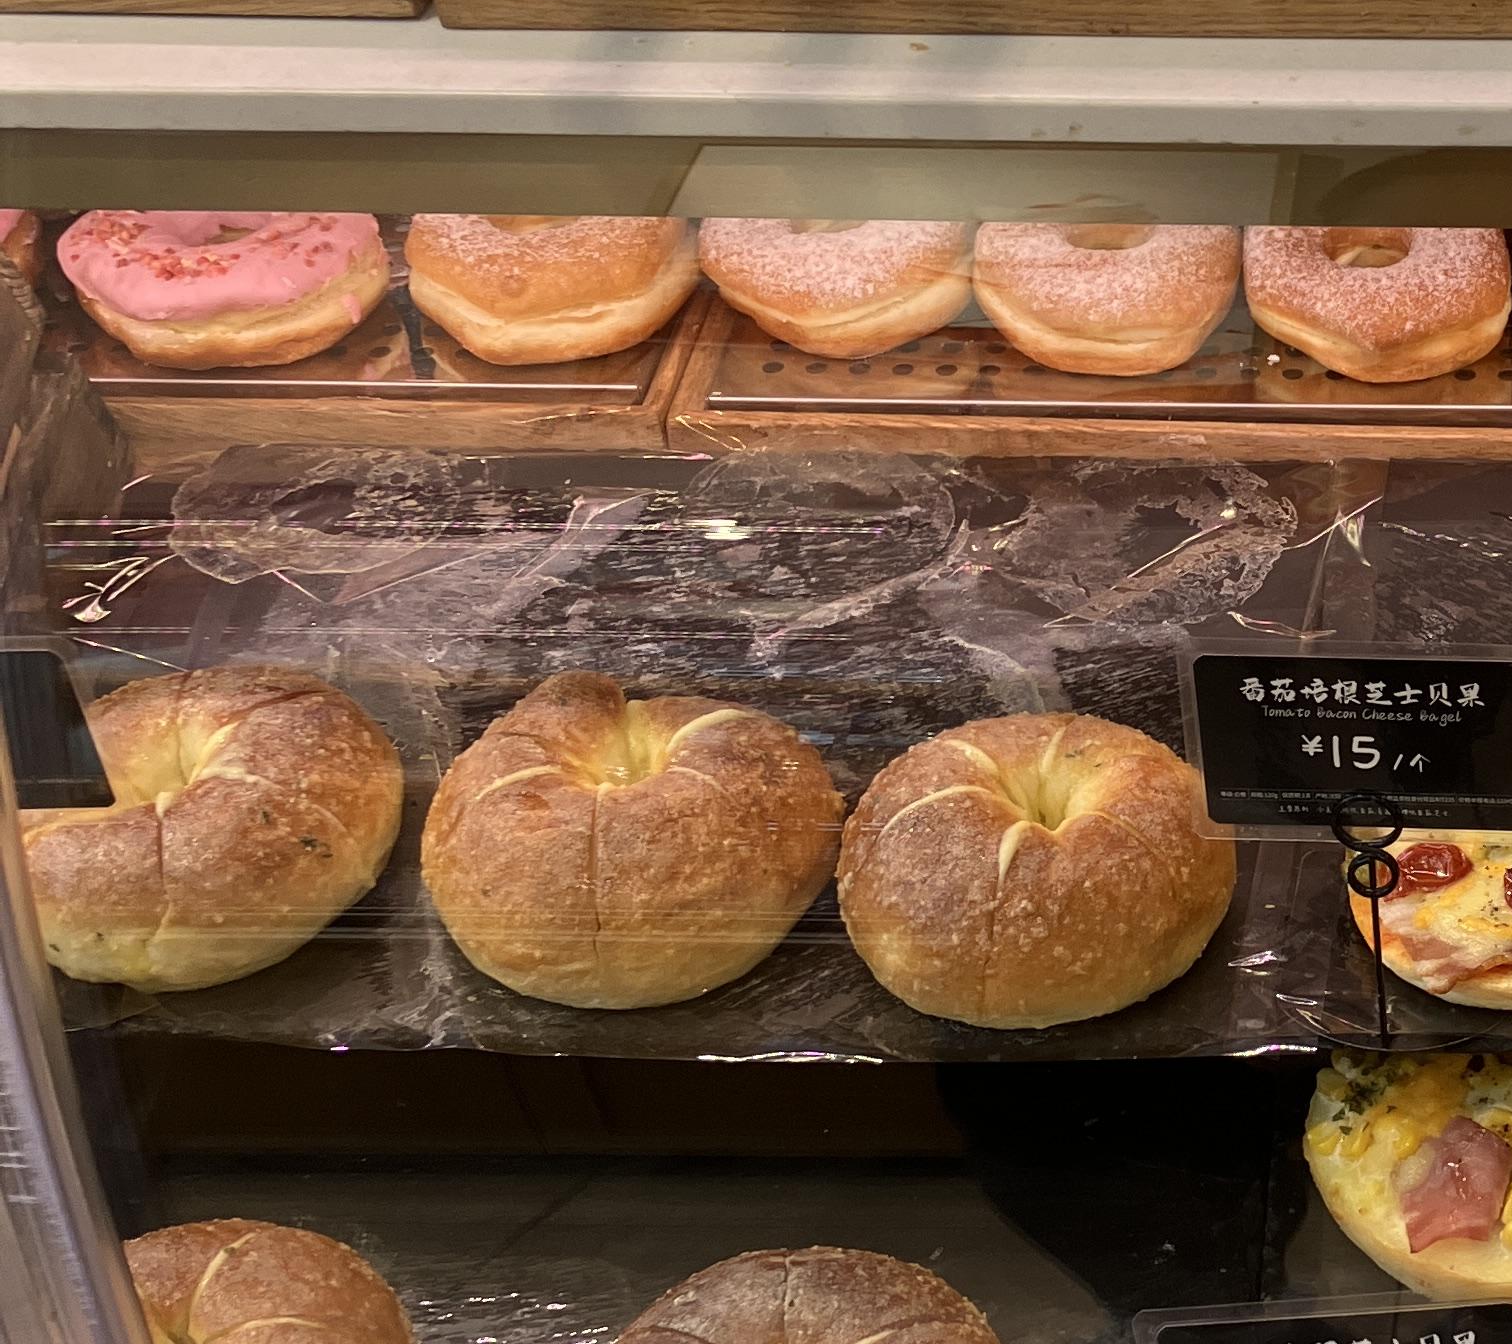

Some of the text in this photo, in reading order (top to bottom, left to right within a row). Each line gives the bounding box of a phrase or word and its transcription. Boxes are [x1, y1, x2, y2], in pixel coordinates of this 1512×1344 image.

[1239, 677, 1485, 707] 番茄培根芝士贝果
[1261, 704, 1463, 727] Tomato Bacon Cheese Bagel
